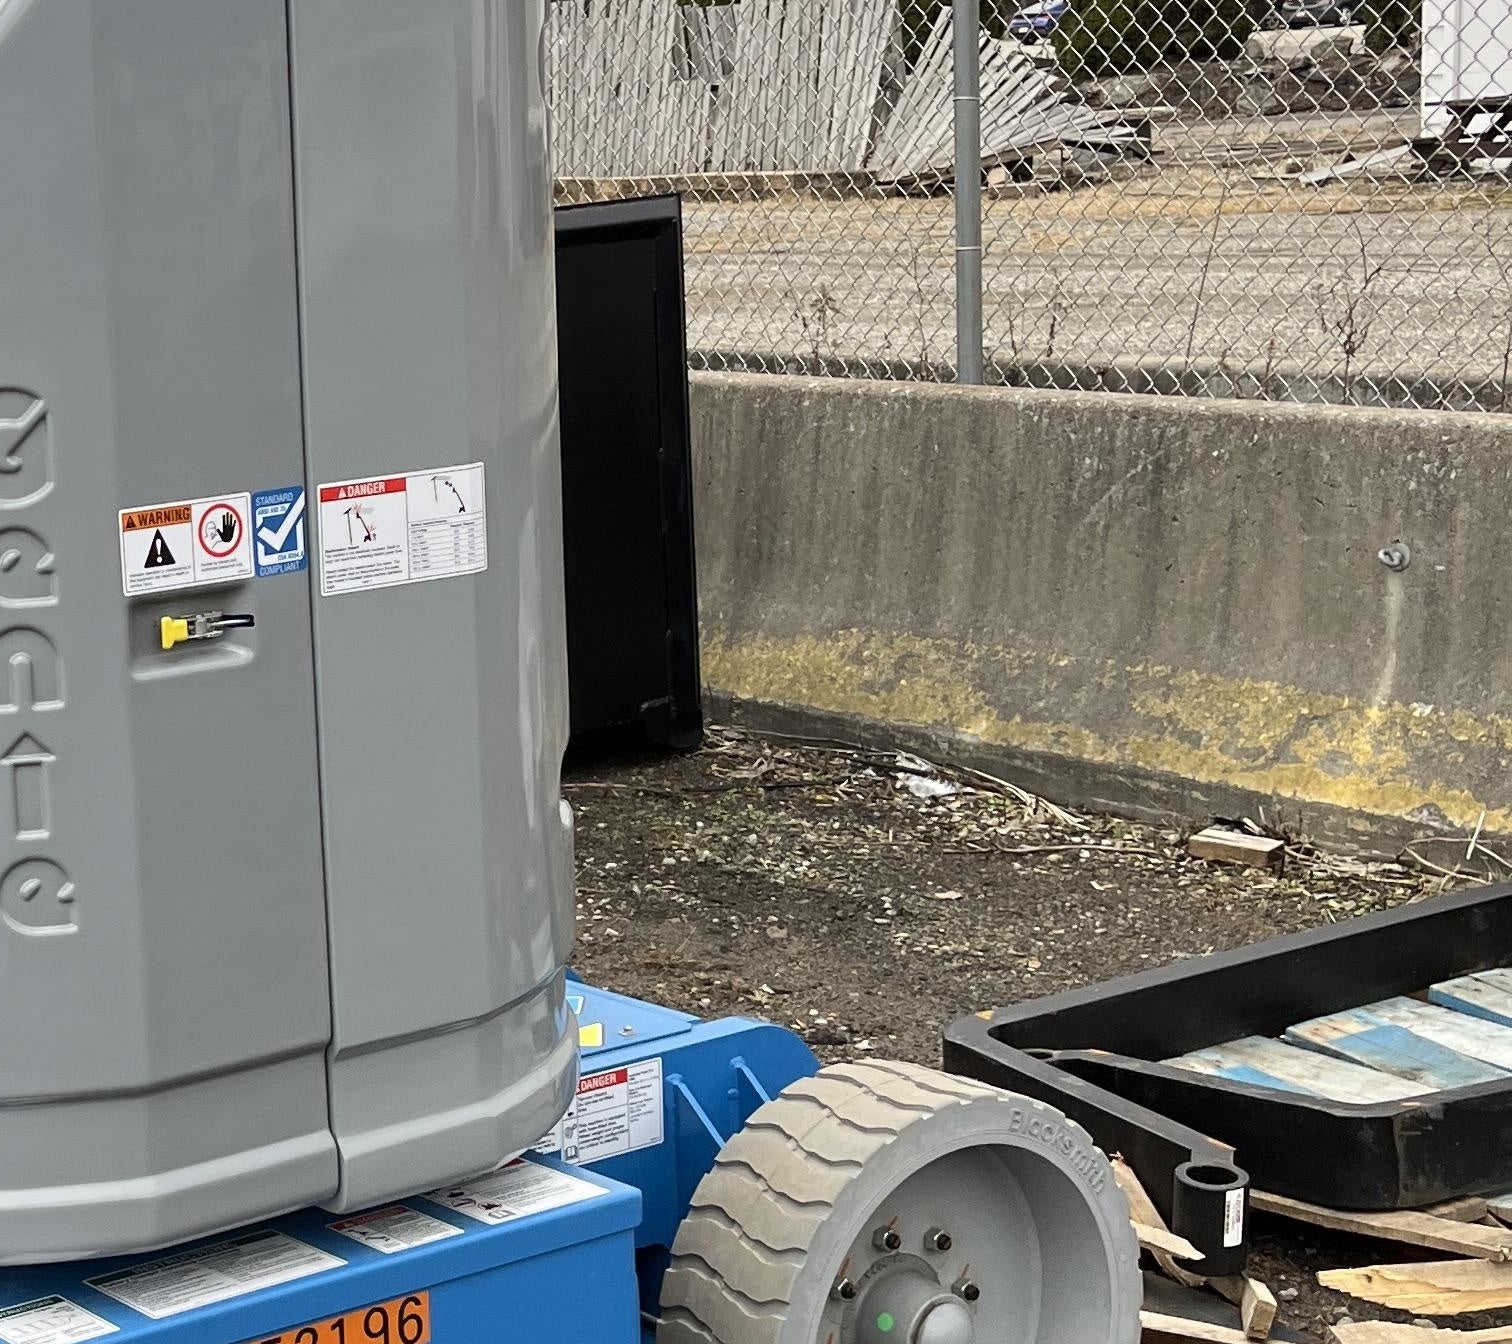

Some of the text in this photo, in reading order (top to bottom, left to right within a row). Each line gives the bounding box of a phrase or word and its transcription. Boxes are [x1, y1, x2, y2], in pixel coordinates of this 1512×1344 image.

[347, 481, 386, 498] DANGER
[255, 492, 294, 507] STANDARD
[138, 507, 191, 527] WARNING
[259, 561, 300, 576] COMPLIANT
[580, 1073, 617, 1091] DANGER
[1008, 1107, 1104, 1195] Blacksmith
